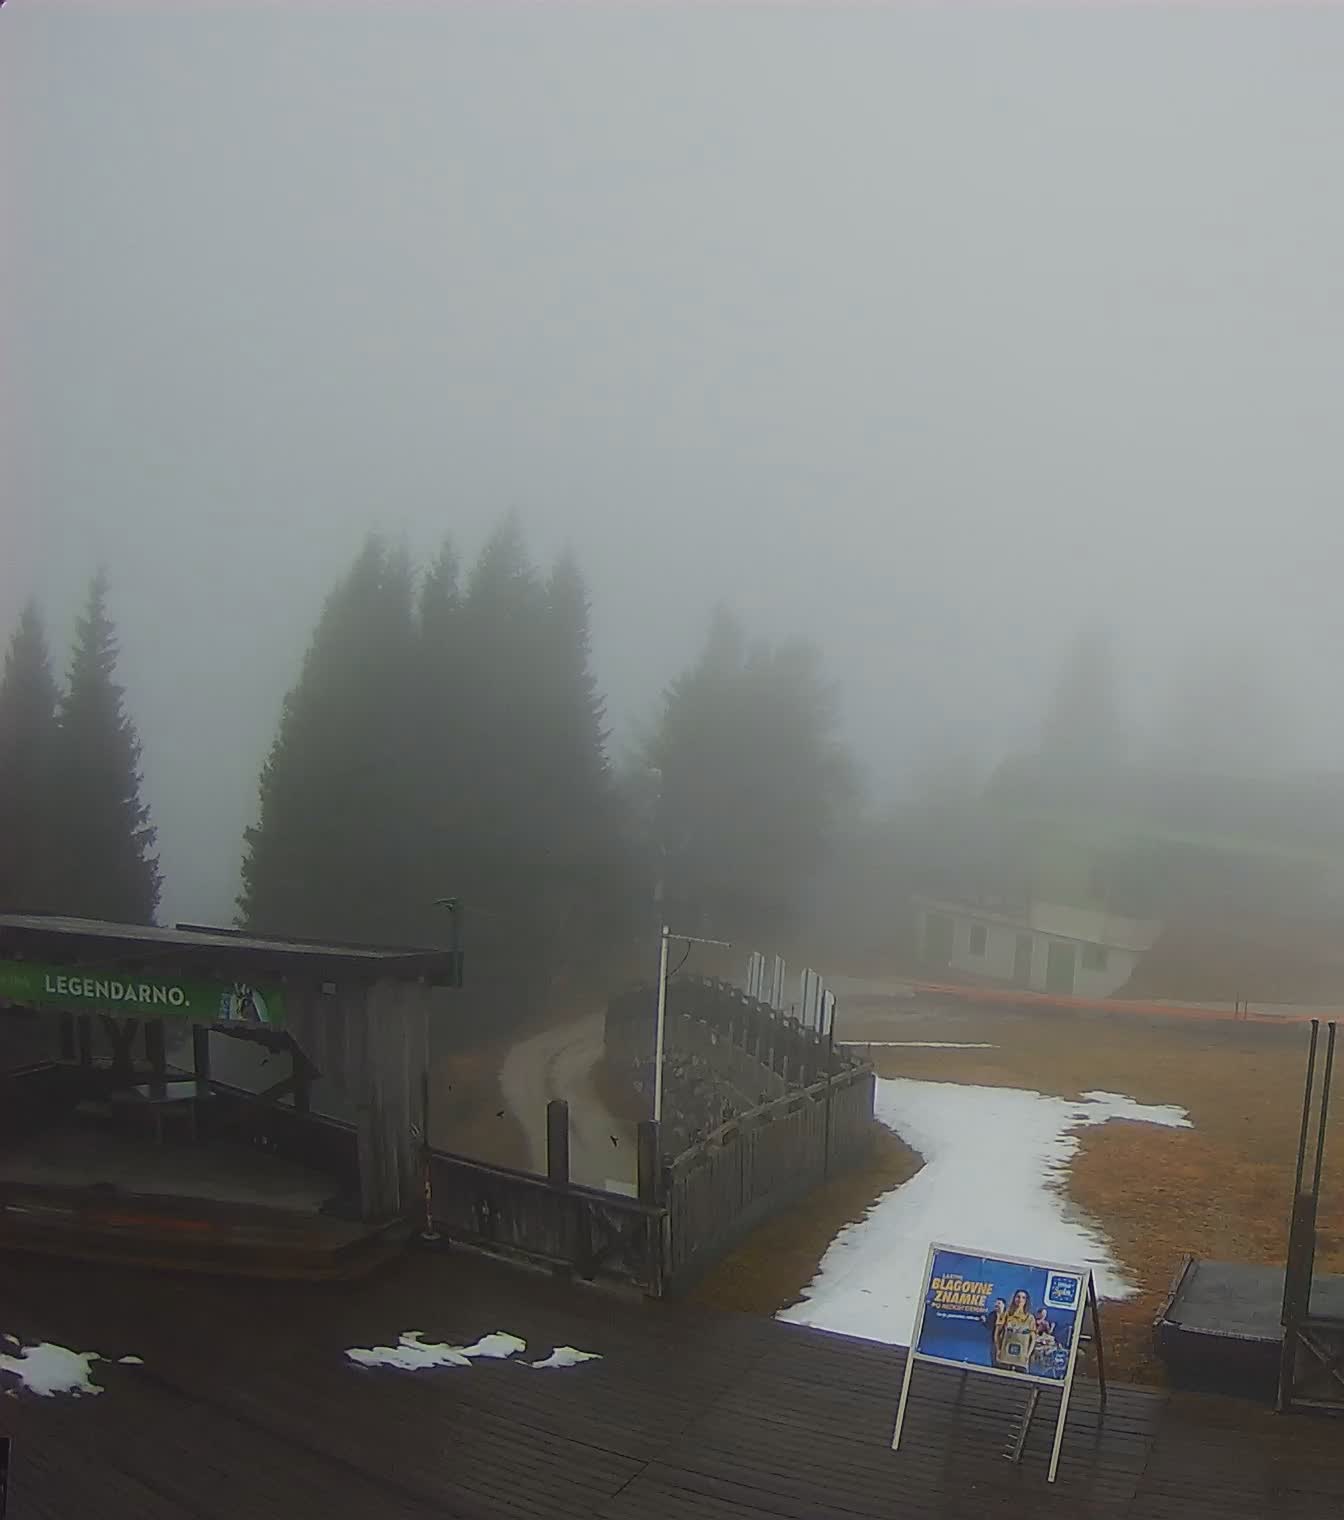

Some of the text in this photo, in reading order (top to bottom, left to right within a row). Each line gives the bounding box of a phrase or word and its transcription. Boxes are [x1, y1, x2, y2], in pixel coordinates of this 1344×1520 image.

[44, 974, 190, 1007] LEGENDARNO.
[931, 1277, 994, 1295] BLAGOVNE
[934, 1290, 987, 1307] ZNAMKE
